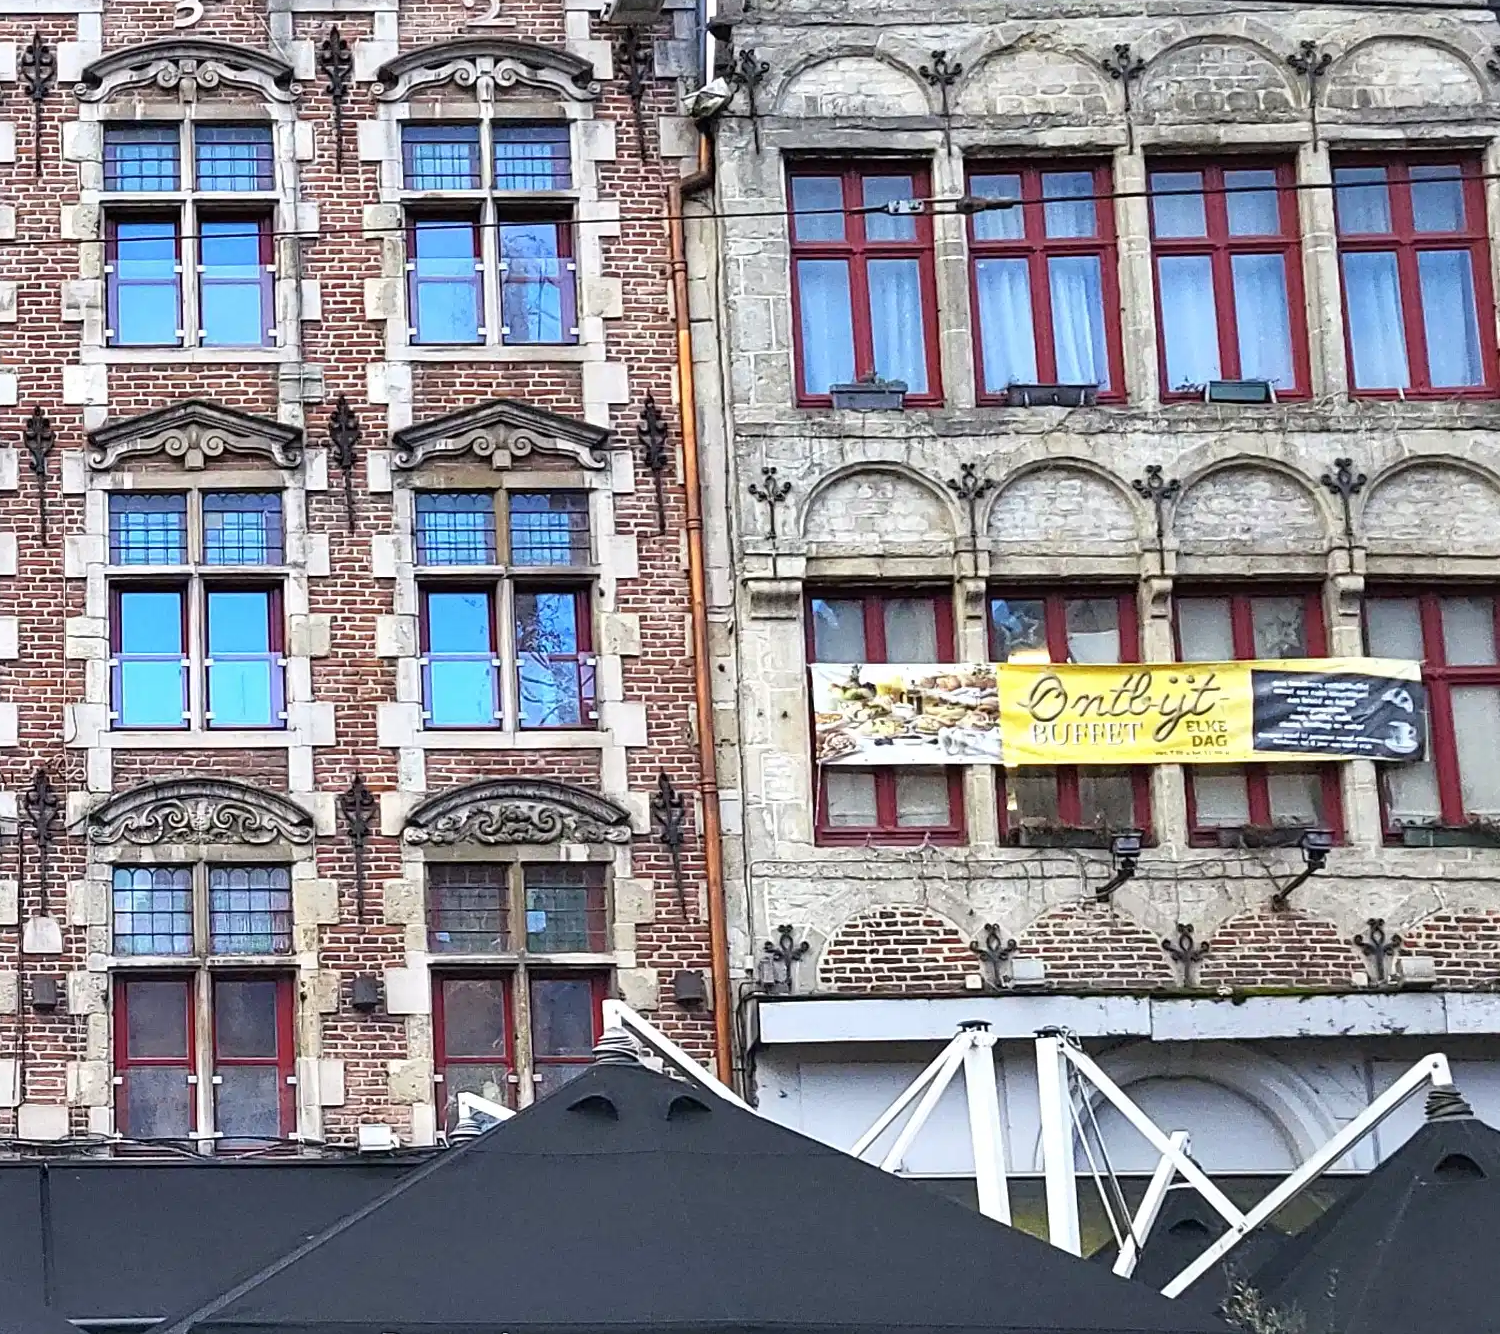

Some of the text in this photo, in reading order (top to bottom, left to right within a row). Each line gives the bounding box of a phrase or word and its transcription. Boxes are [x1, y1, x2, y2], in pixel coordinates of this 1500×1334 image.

[1186, 720, 1229, 734] ELKE
[1031, 722, 1145, 747] BUFFET
[1192, 735, 1228, 748] DAG
